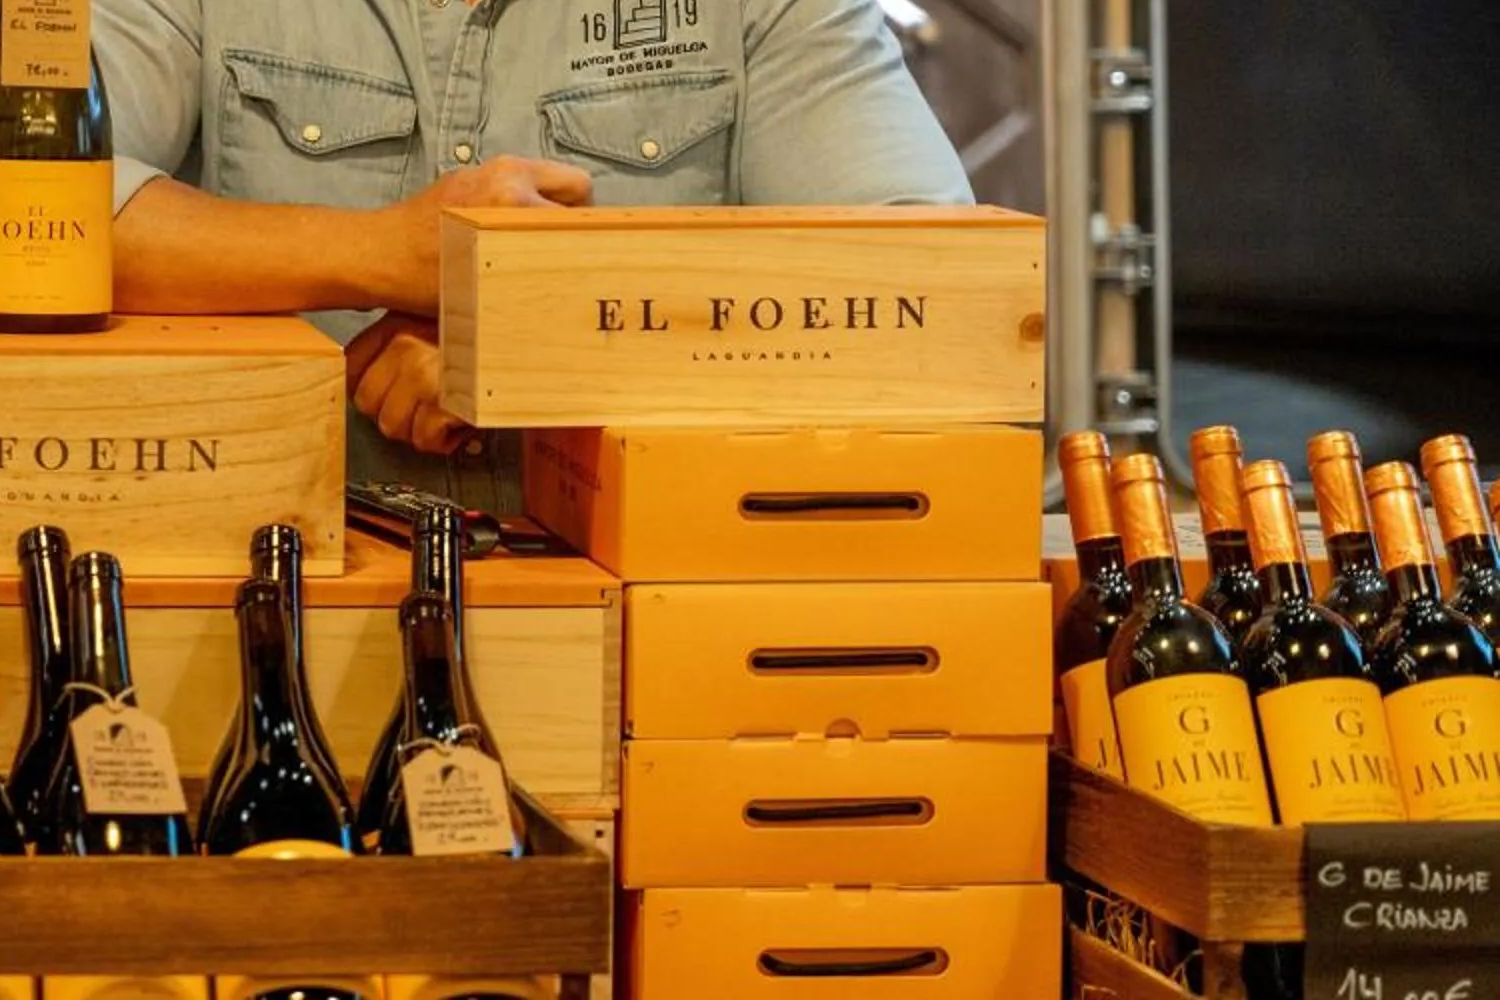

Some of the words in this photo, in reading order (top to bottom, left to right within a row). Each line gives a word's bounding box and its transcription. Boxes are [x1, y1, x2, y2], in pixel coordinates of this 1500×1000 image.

[581, 13, 607, 43] 16
[571, 55, 615, 71] MAYOR
[619, 49, 636, 62] DE
[643, 41, 709, 58] MIGUELOA
[607, 60, 674, 76] BODEGAS
[596, 298, 669, 331] EL
[708, 296, 928, 331] FOEHN
[692, 351, 831, 362] LAGUARDIA
[1179, 705, 1210, 735] G
[1335, 709, 1364, 738] G
[1434, 708, 1466, 738] G
[1153, 748, 1251, 790] JAIME
[1318, 861, 1346, 888] G
[1363, 866, 1403, 890] DE
[1409, 861, 1491, 894] JAIME
[1343, 902, 1469, 930] CRIANZA
